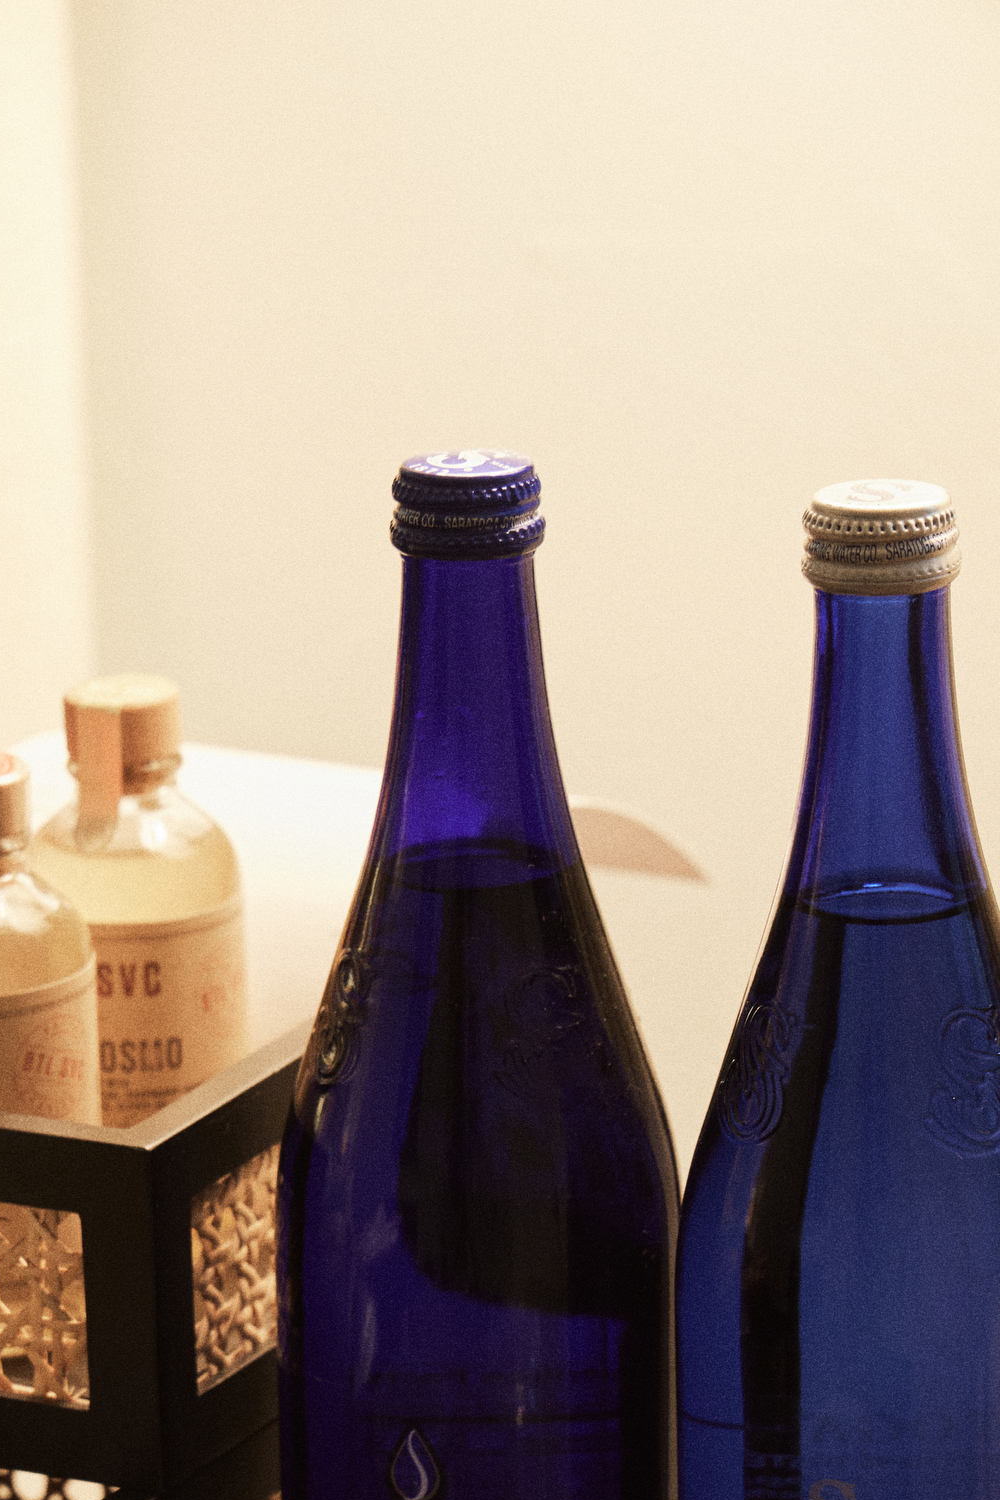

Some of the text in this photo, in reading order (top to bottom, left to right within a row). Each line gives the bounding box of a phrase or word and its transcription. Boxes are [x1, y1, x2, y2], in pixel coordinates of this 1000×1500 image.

[833, 544, 862, 563] WATER
[97, 961, 161, 998] SVC
[22, 1051, 55, 1076] BTL
